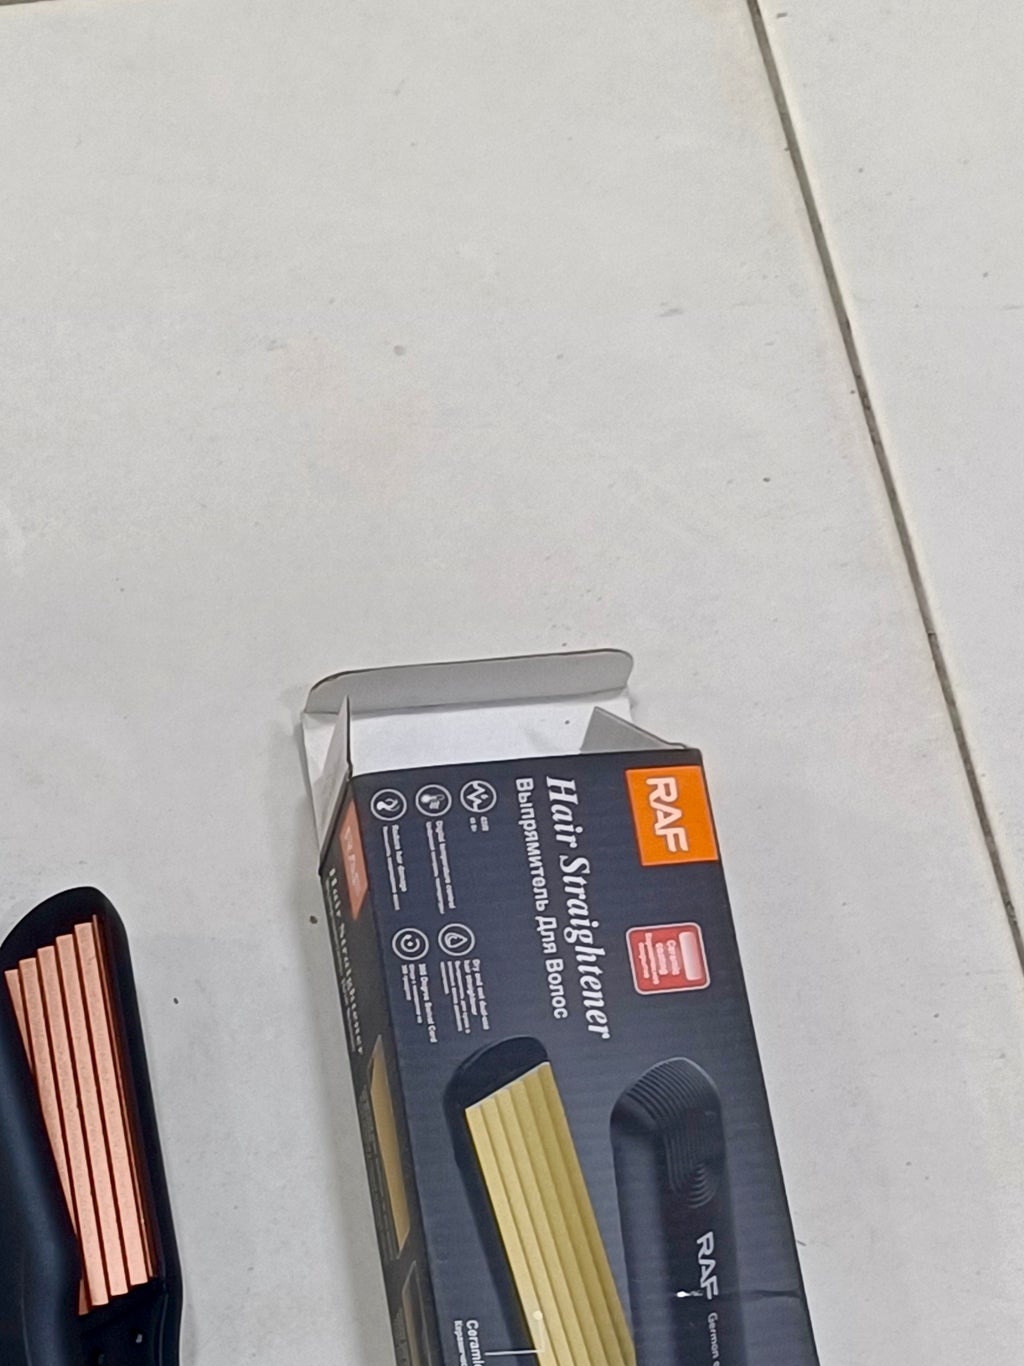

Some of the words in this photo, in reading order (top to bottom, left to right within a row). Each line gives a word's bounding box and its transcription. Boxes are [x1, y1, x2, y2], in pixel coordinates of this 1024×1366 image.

[515, 777, 549, 911] Выпрямитель
[545, 776, 583, 848] Hair
[646, 776, 688, 852] RAF
[534, 915, 557, 953] Для
[559, 855, 610, 1038] Straightener
[544, 958, 568, 1019] Волос
[696, 1231, 718, 1299] RAF
[707, 1311, 719, 1358] German
